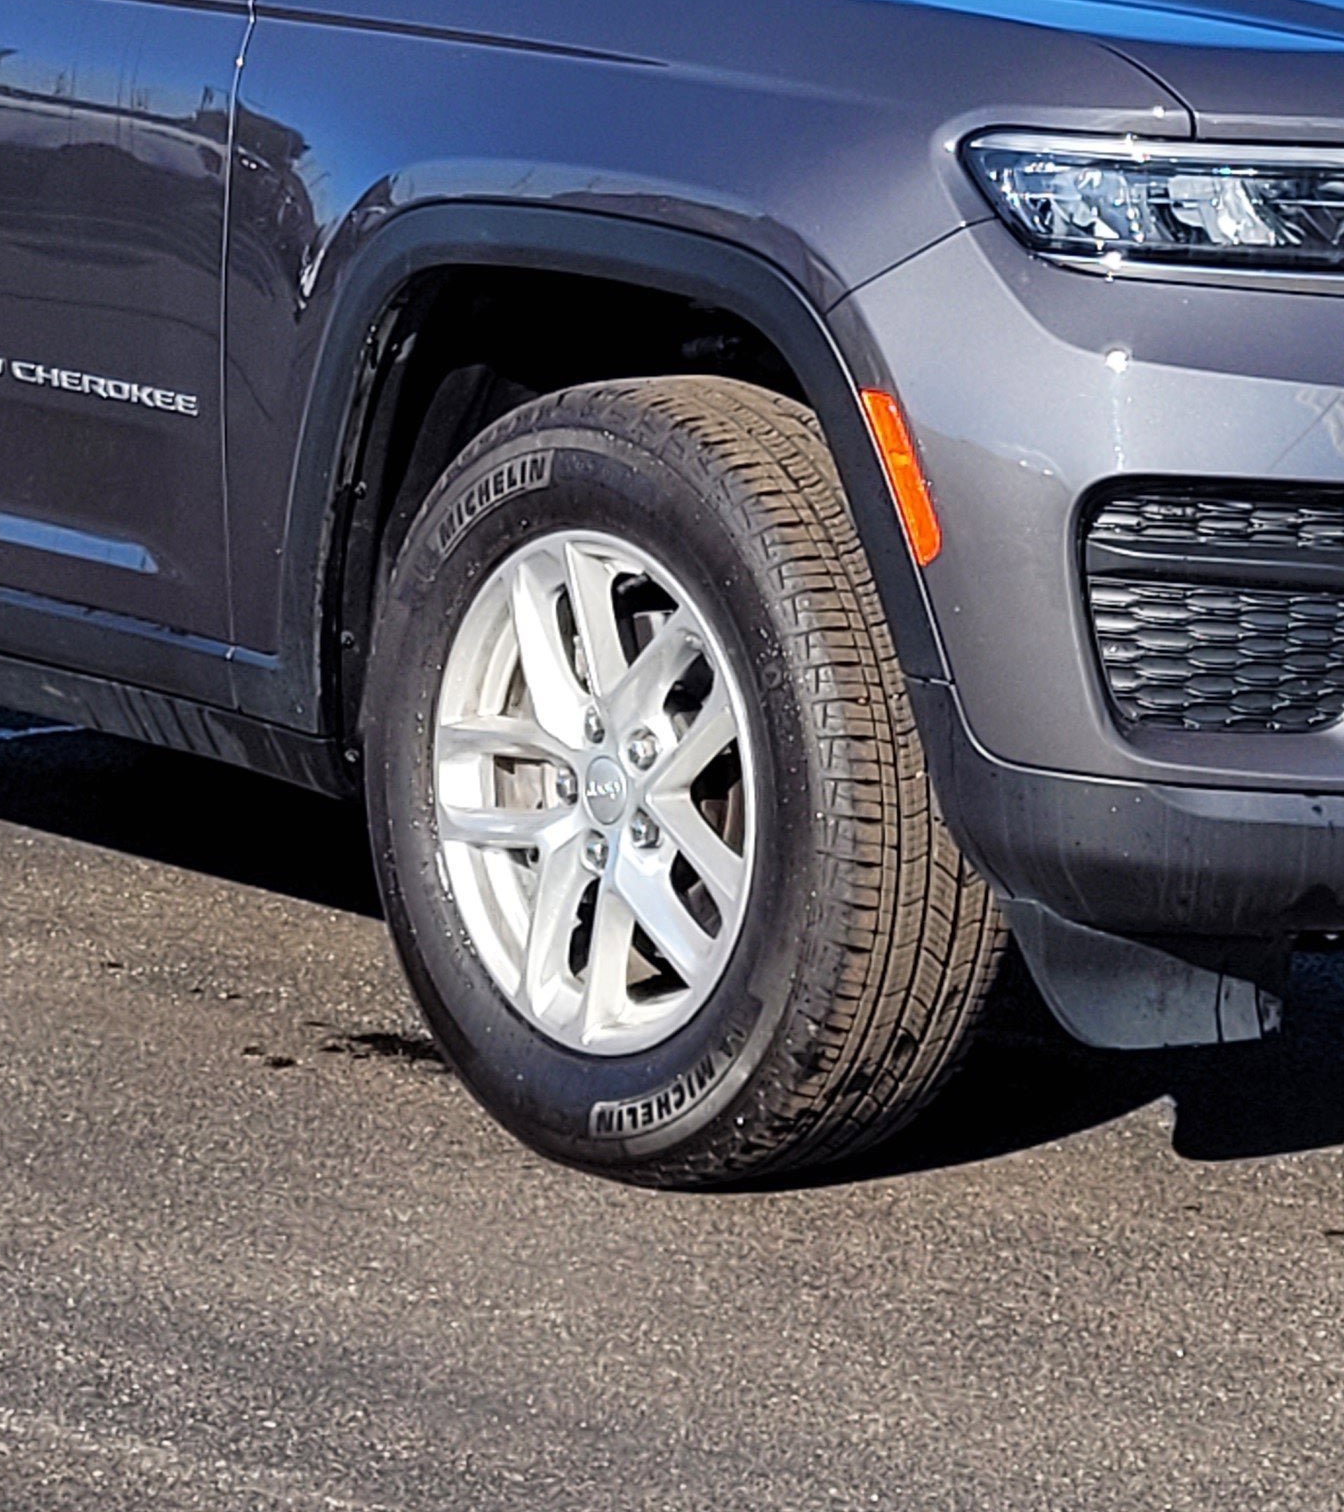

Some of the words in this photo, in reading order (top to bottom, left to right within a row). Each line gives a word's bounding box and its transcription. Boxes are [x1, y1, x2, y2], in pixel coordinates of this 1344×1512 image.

[10, 360, 199, 416] CHEROKEE
[438, 455, 546, 549] MICHELIN
[596, 1053, 717, 1133] MICHELIN
